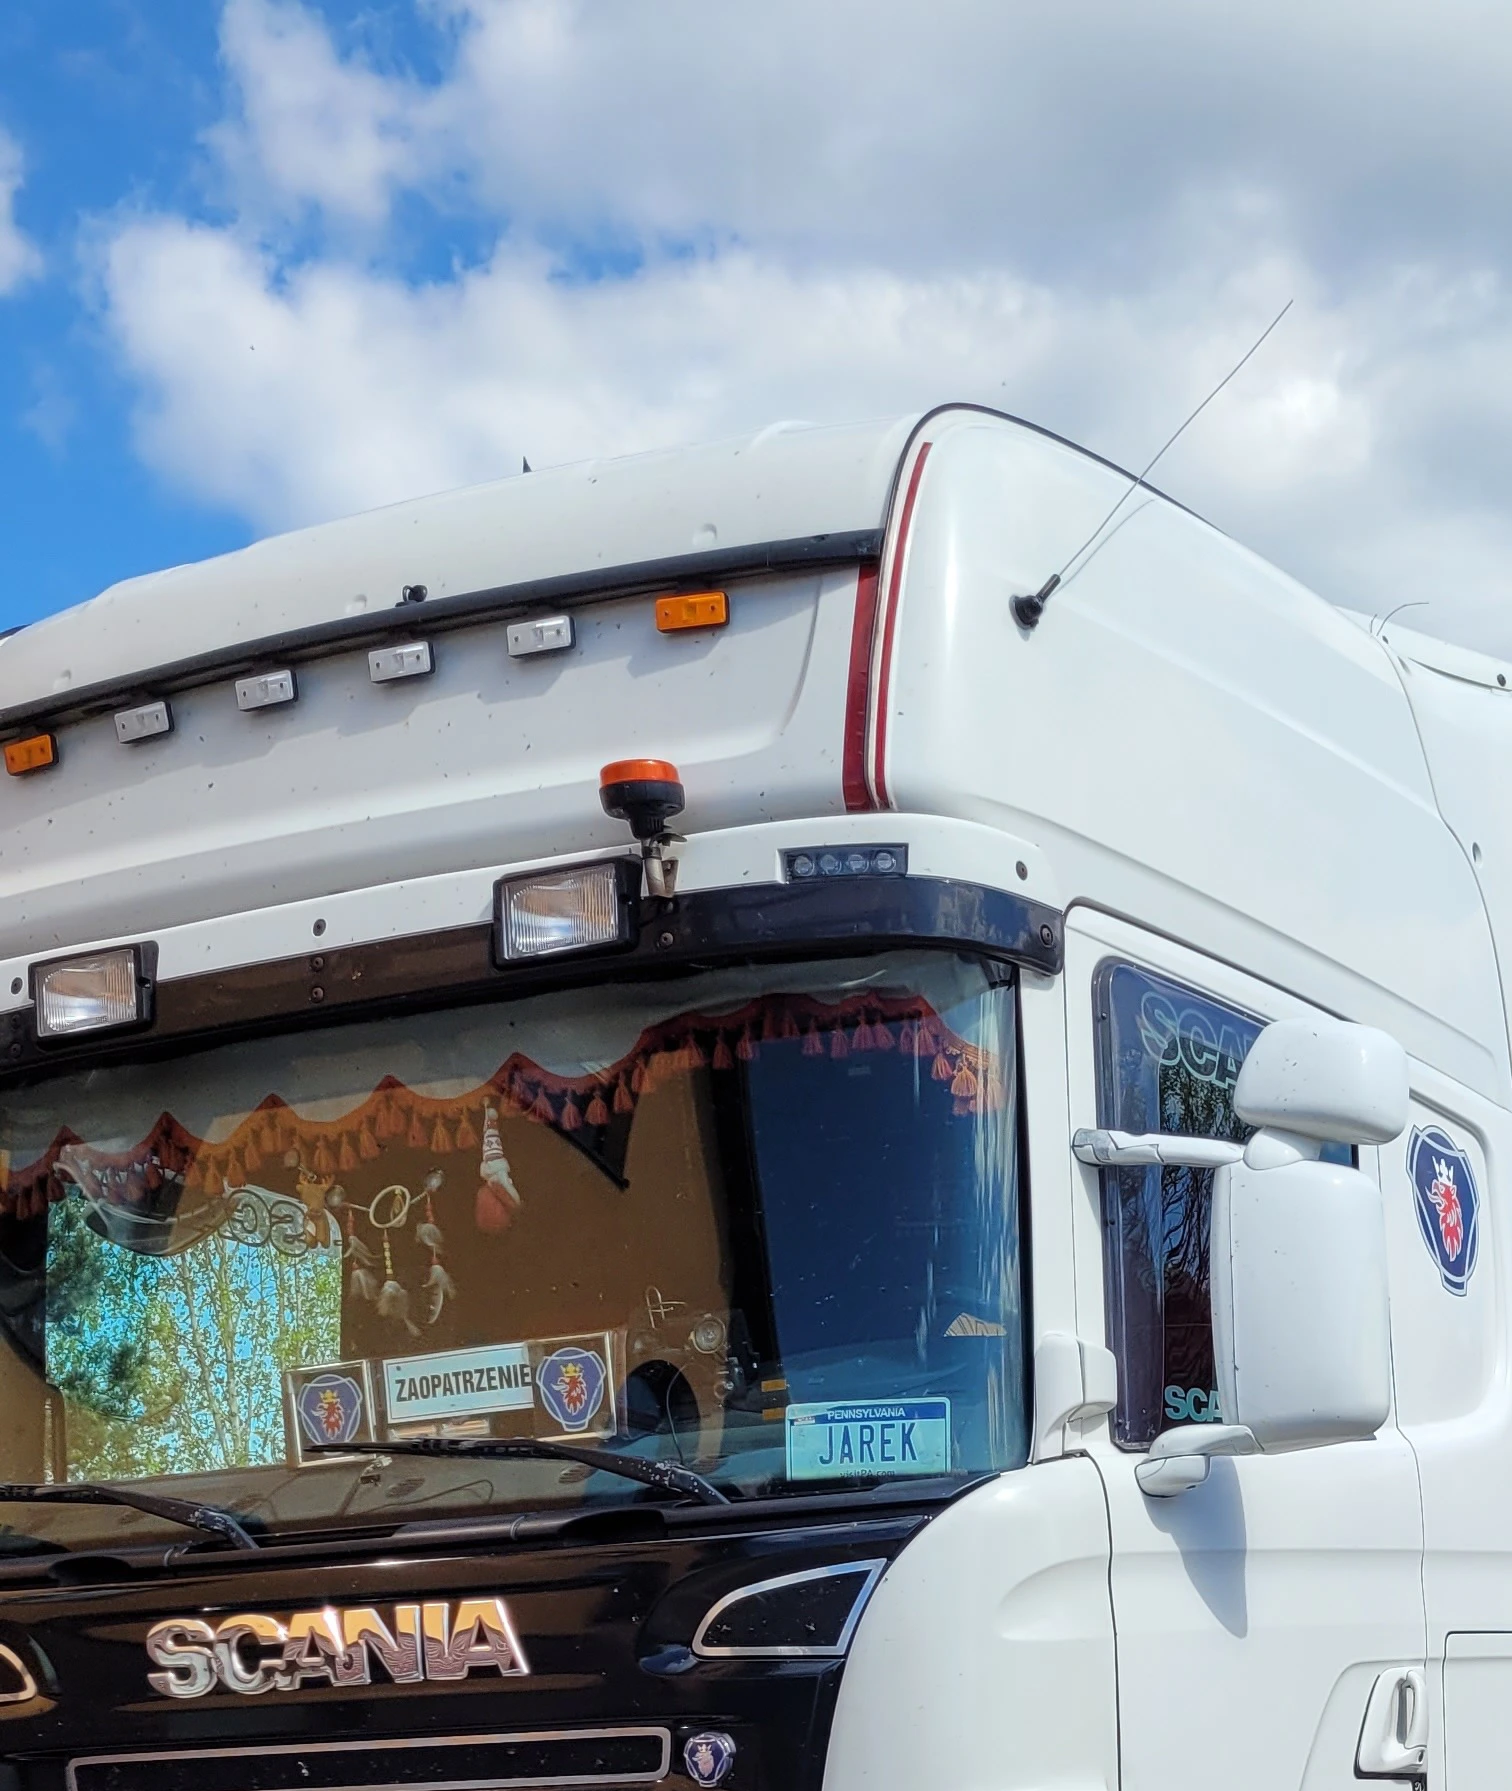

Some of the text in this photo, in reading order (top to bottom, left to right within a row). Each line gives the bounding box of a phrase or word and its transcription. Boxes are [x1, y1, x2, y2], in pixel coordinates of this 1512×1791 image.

[1141, 991, 1253, 1089] SCA
[394, 1363, 532, 1402] ZAOPATRZENIE
[827, 1407, 906, 1421] PENNSYLVANIA
[819, 1422, 918, 1465] JAREK
[146, 1598, 530, 1699] SCANIA
